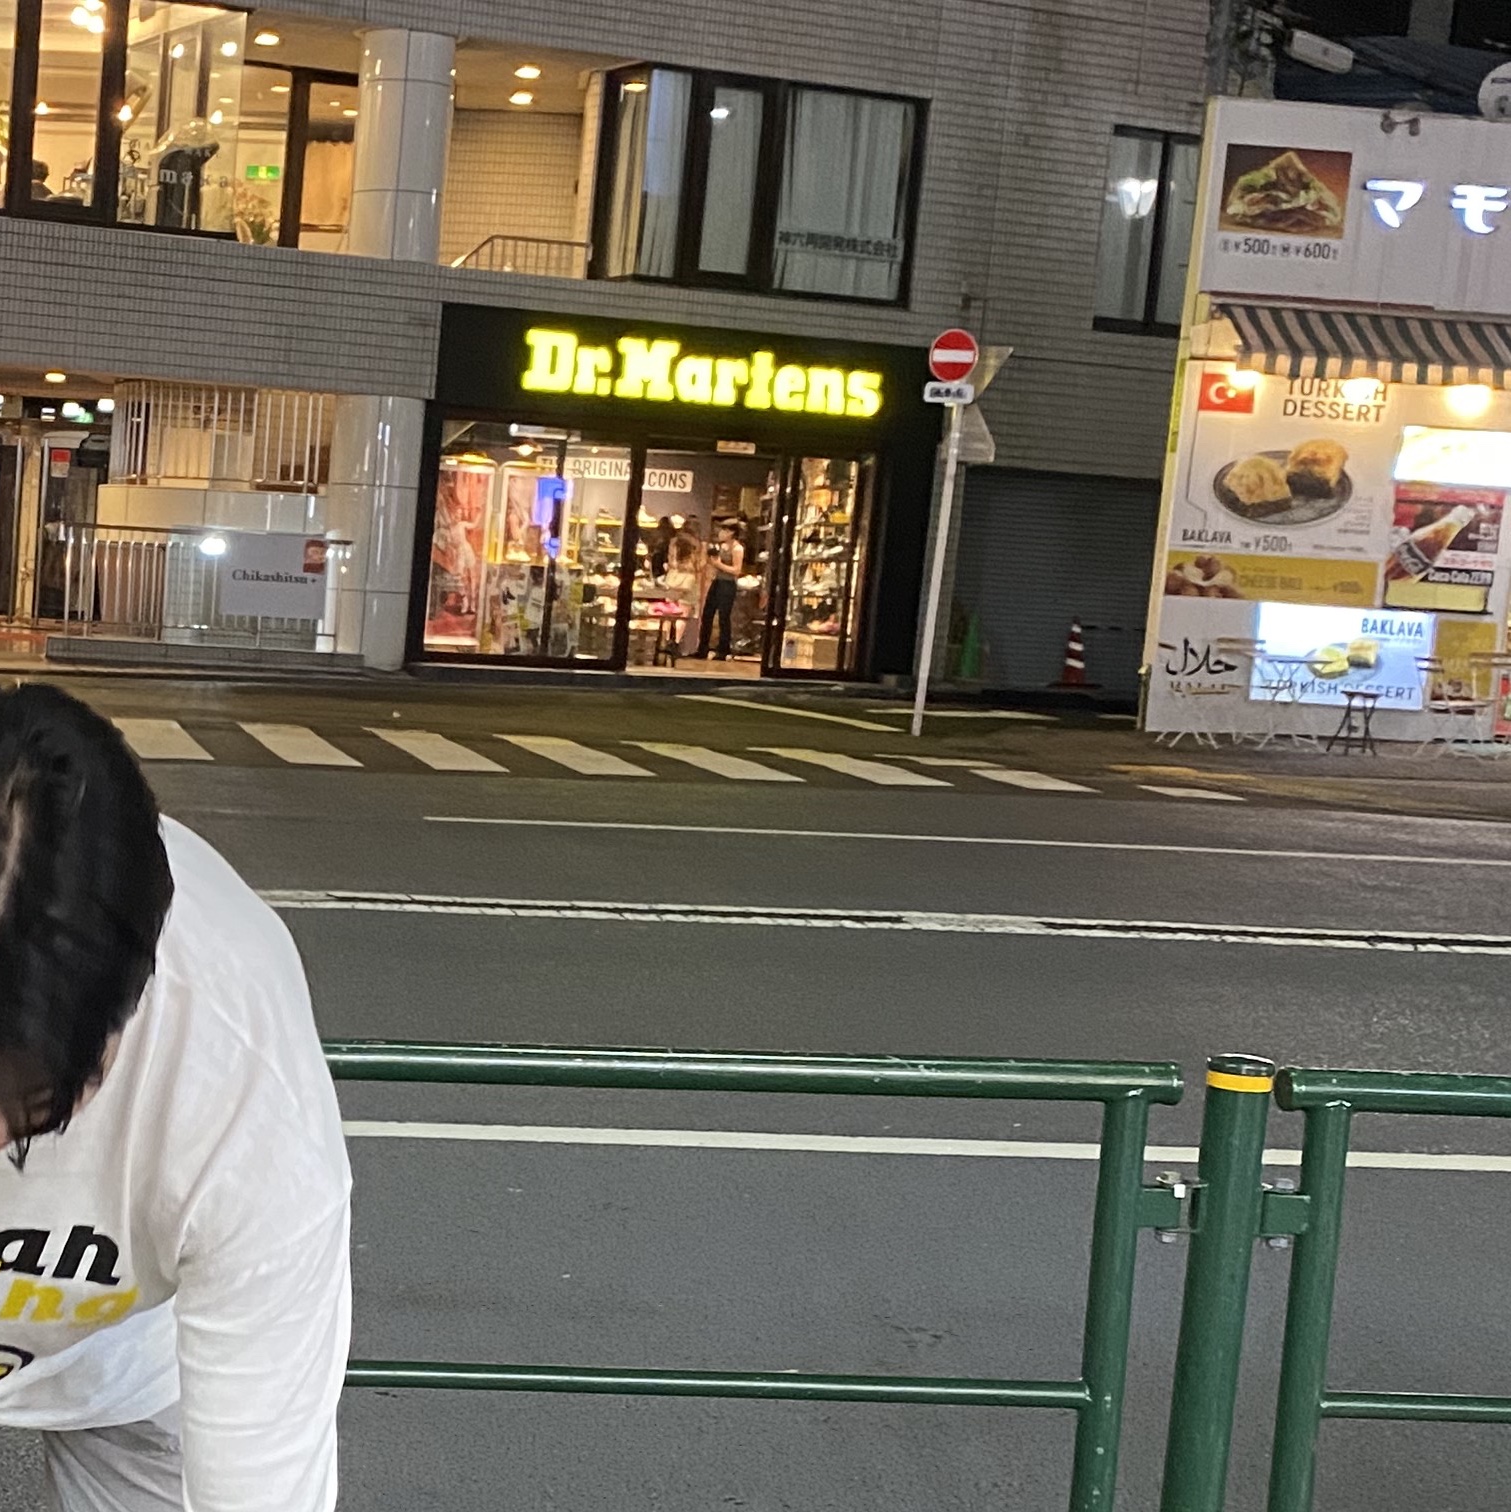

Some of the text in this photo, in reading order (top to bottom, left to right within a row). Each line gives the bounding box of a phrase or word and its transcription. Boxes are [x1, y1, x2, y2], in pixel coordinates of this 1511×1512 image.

[521, 328, 883, 418] Dr.Martens
[1288, 378, 1388, 402] TURKH
[1283, 398, 1387, 422] DESSERT
[572, 458, 631, 478] ORIGINA
[647, 471, 688, 490] CONS
[1181, 527, 1232, 545] BAKLAVA
[1360, 617, 1424, 638] BAKLAVA
